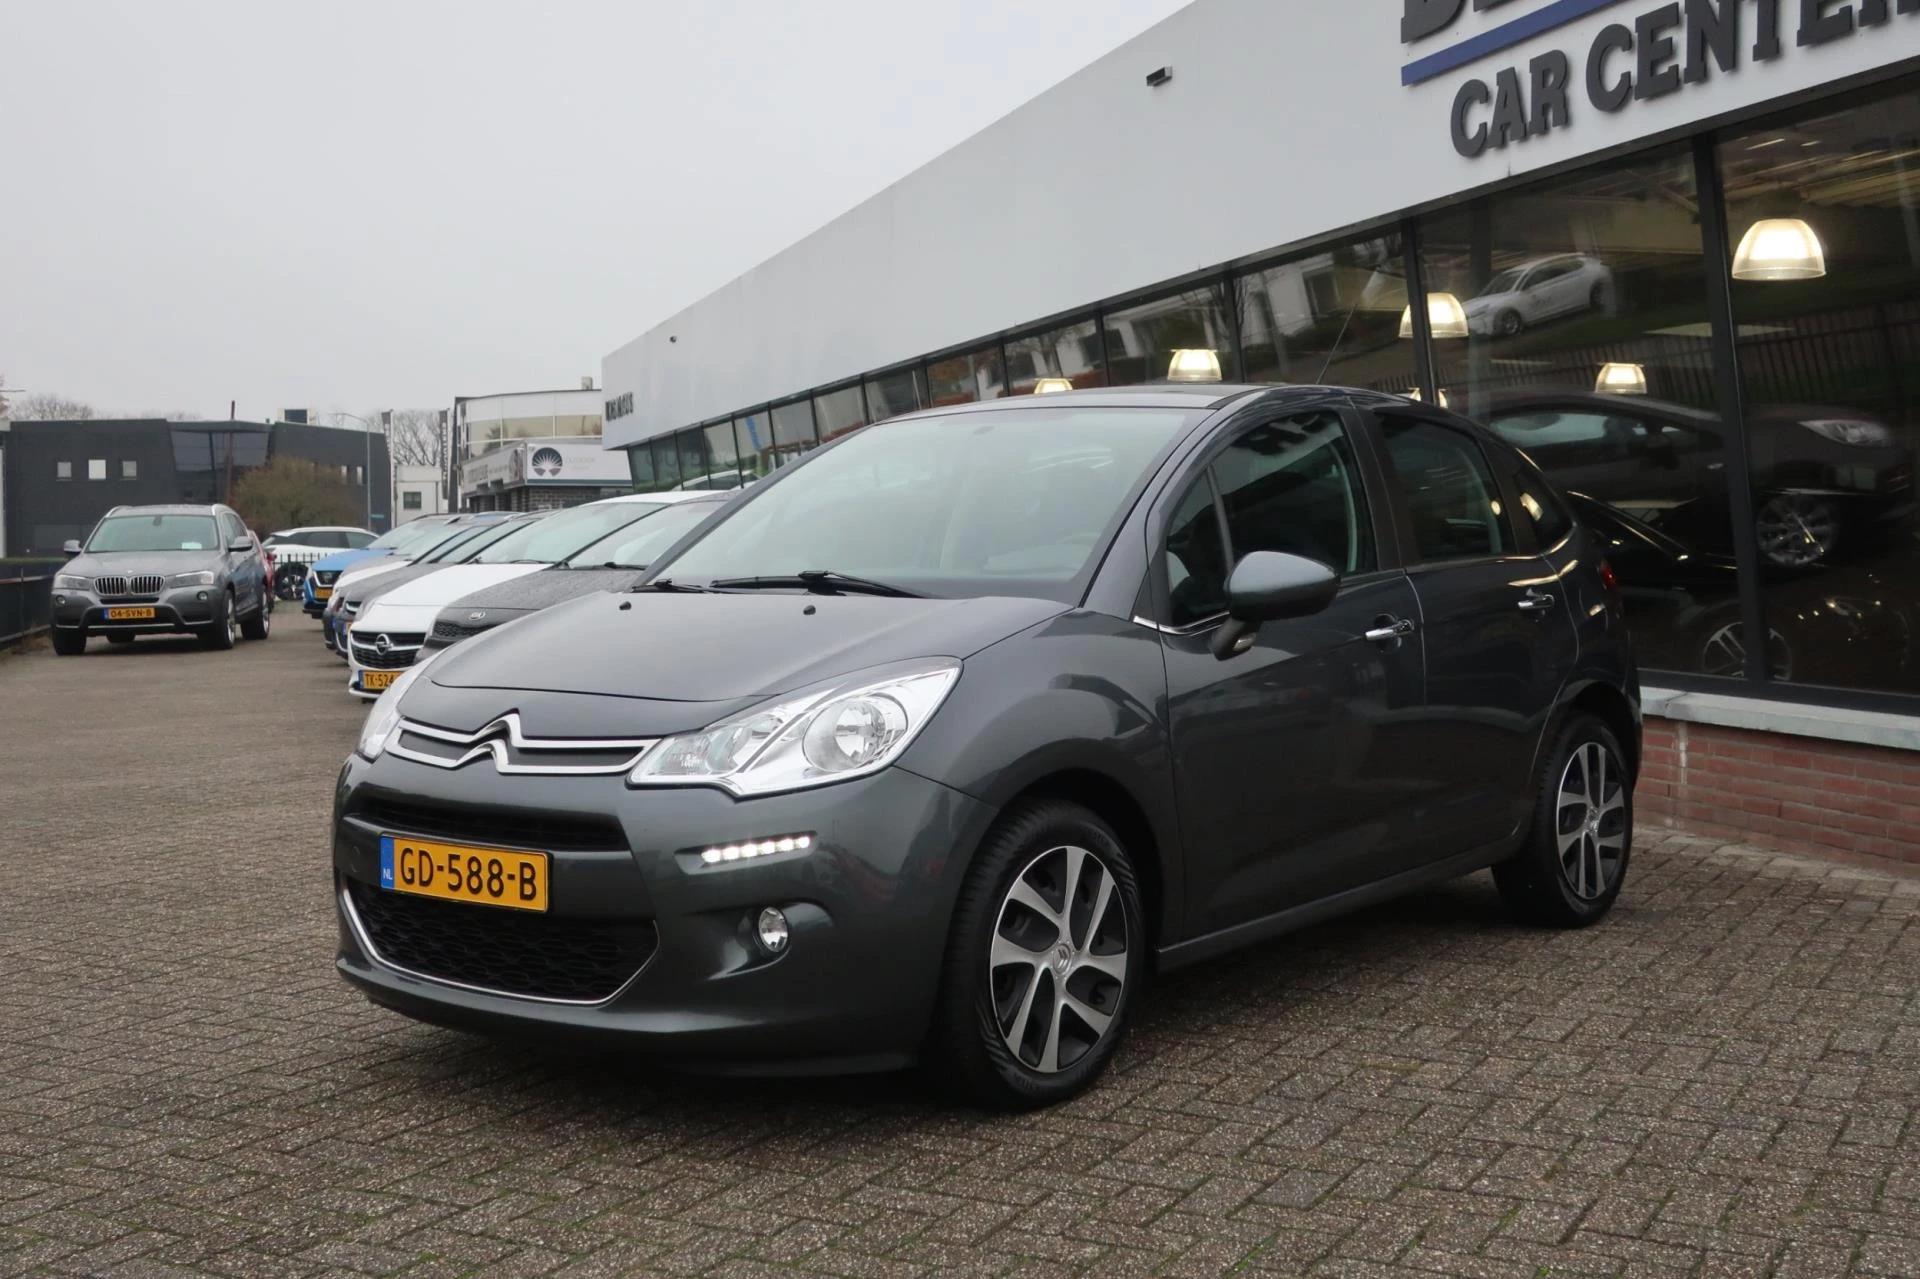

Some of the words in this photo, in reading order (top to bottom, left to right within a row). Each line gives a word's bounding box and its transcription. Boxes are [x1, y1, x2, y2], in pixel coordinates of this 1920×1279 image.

[1450, 49, 1568, 157] CAR
[382, 869, 394, 880] NL
[400, 847, 538, 901] GD-588-B
